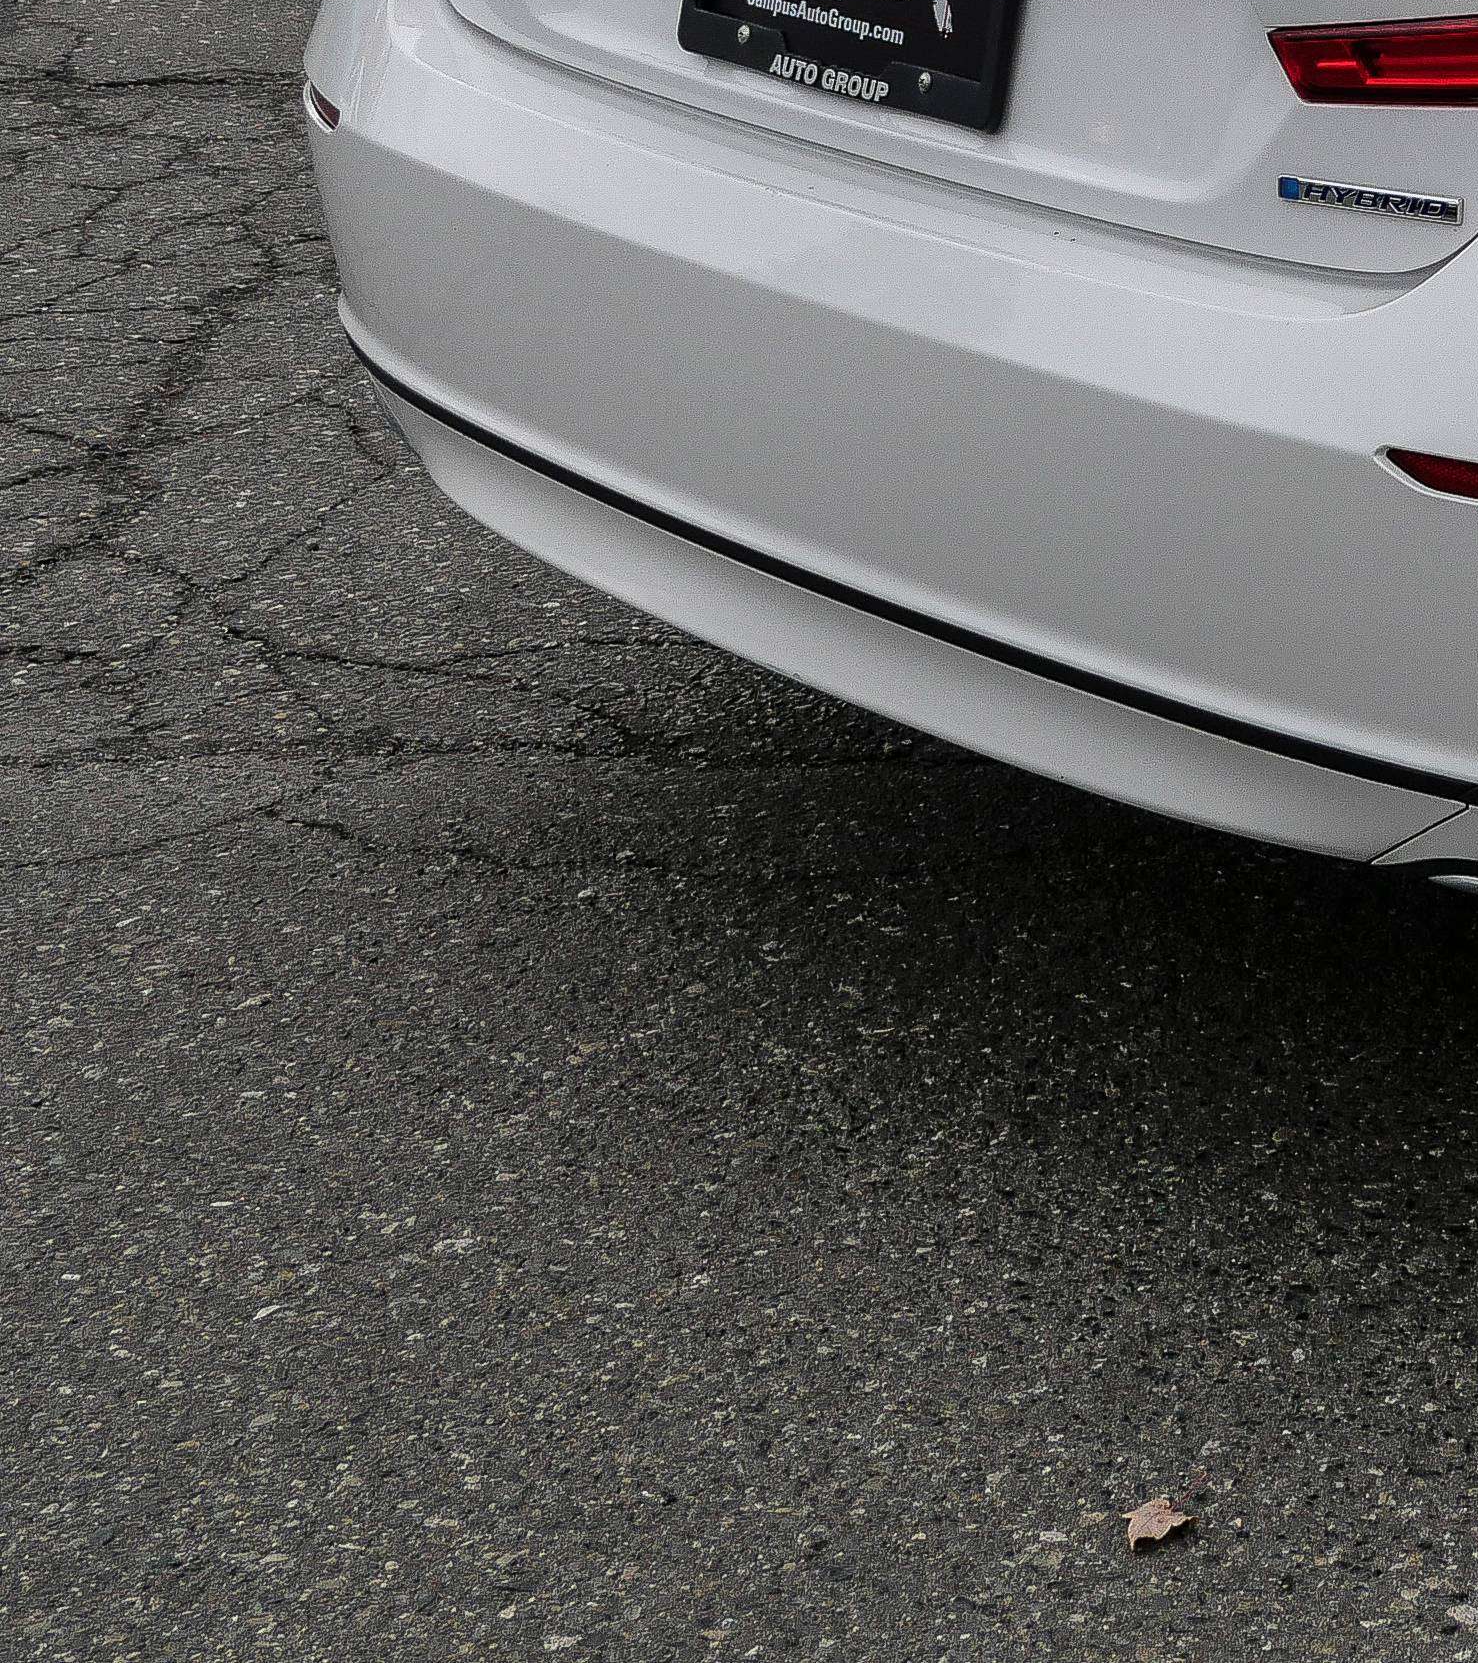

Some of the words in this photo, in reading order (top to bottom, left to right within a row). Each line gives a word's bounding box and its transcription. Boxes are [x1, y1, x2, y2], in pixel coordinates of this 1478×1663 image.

[769, 54, 819, 85] AUTO
[821, 68, 890, 102] GROUP
[1302, 184, 1448, 220] HYBRID
